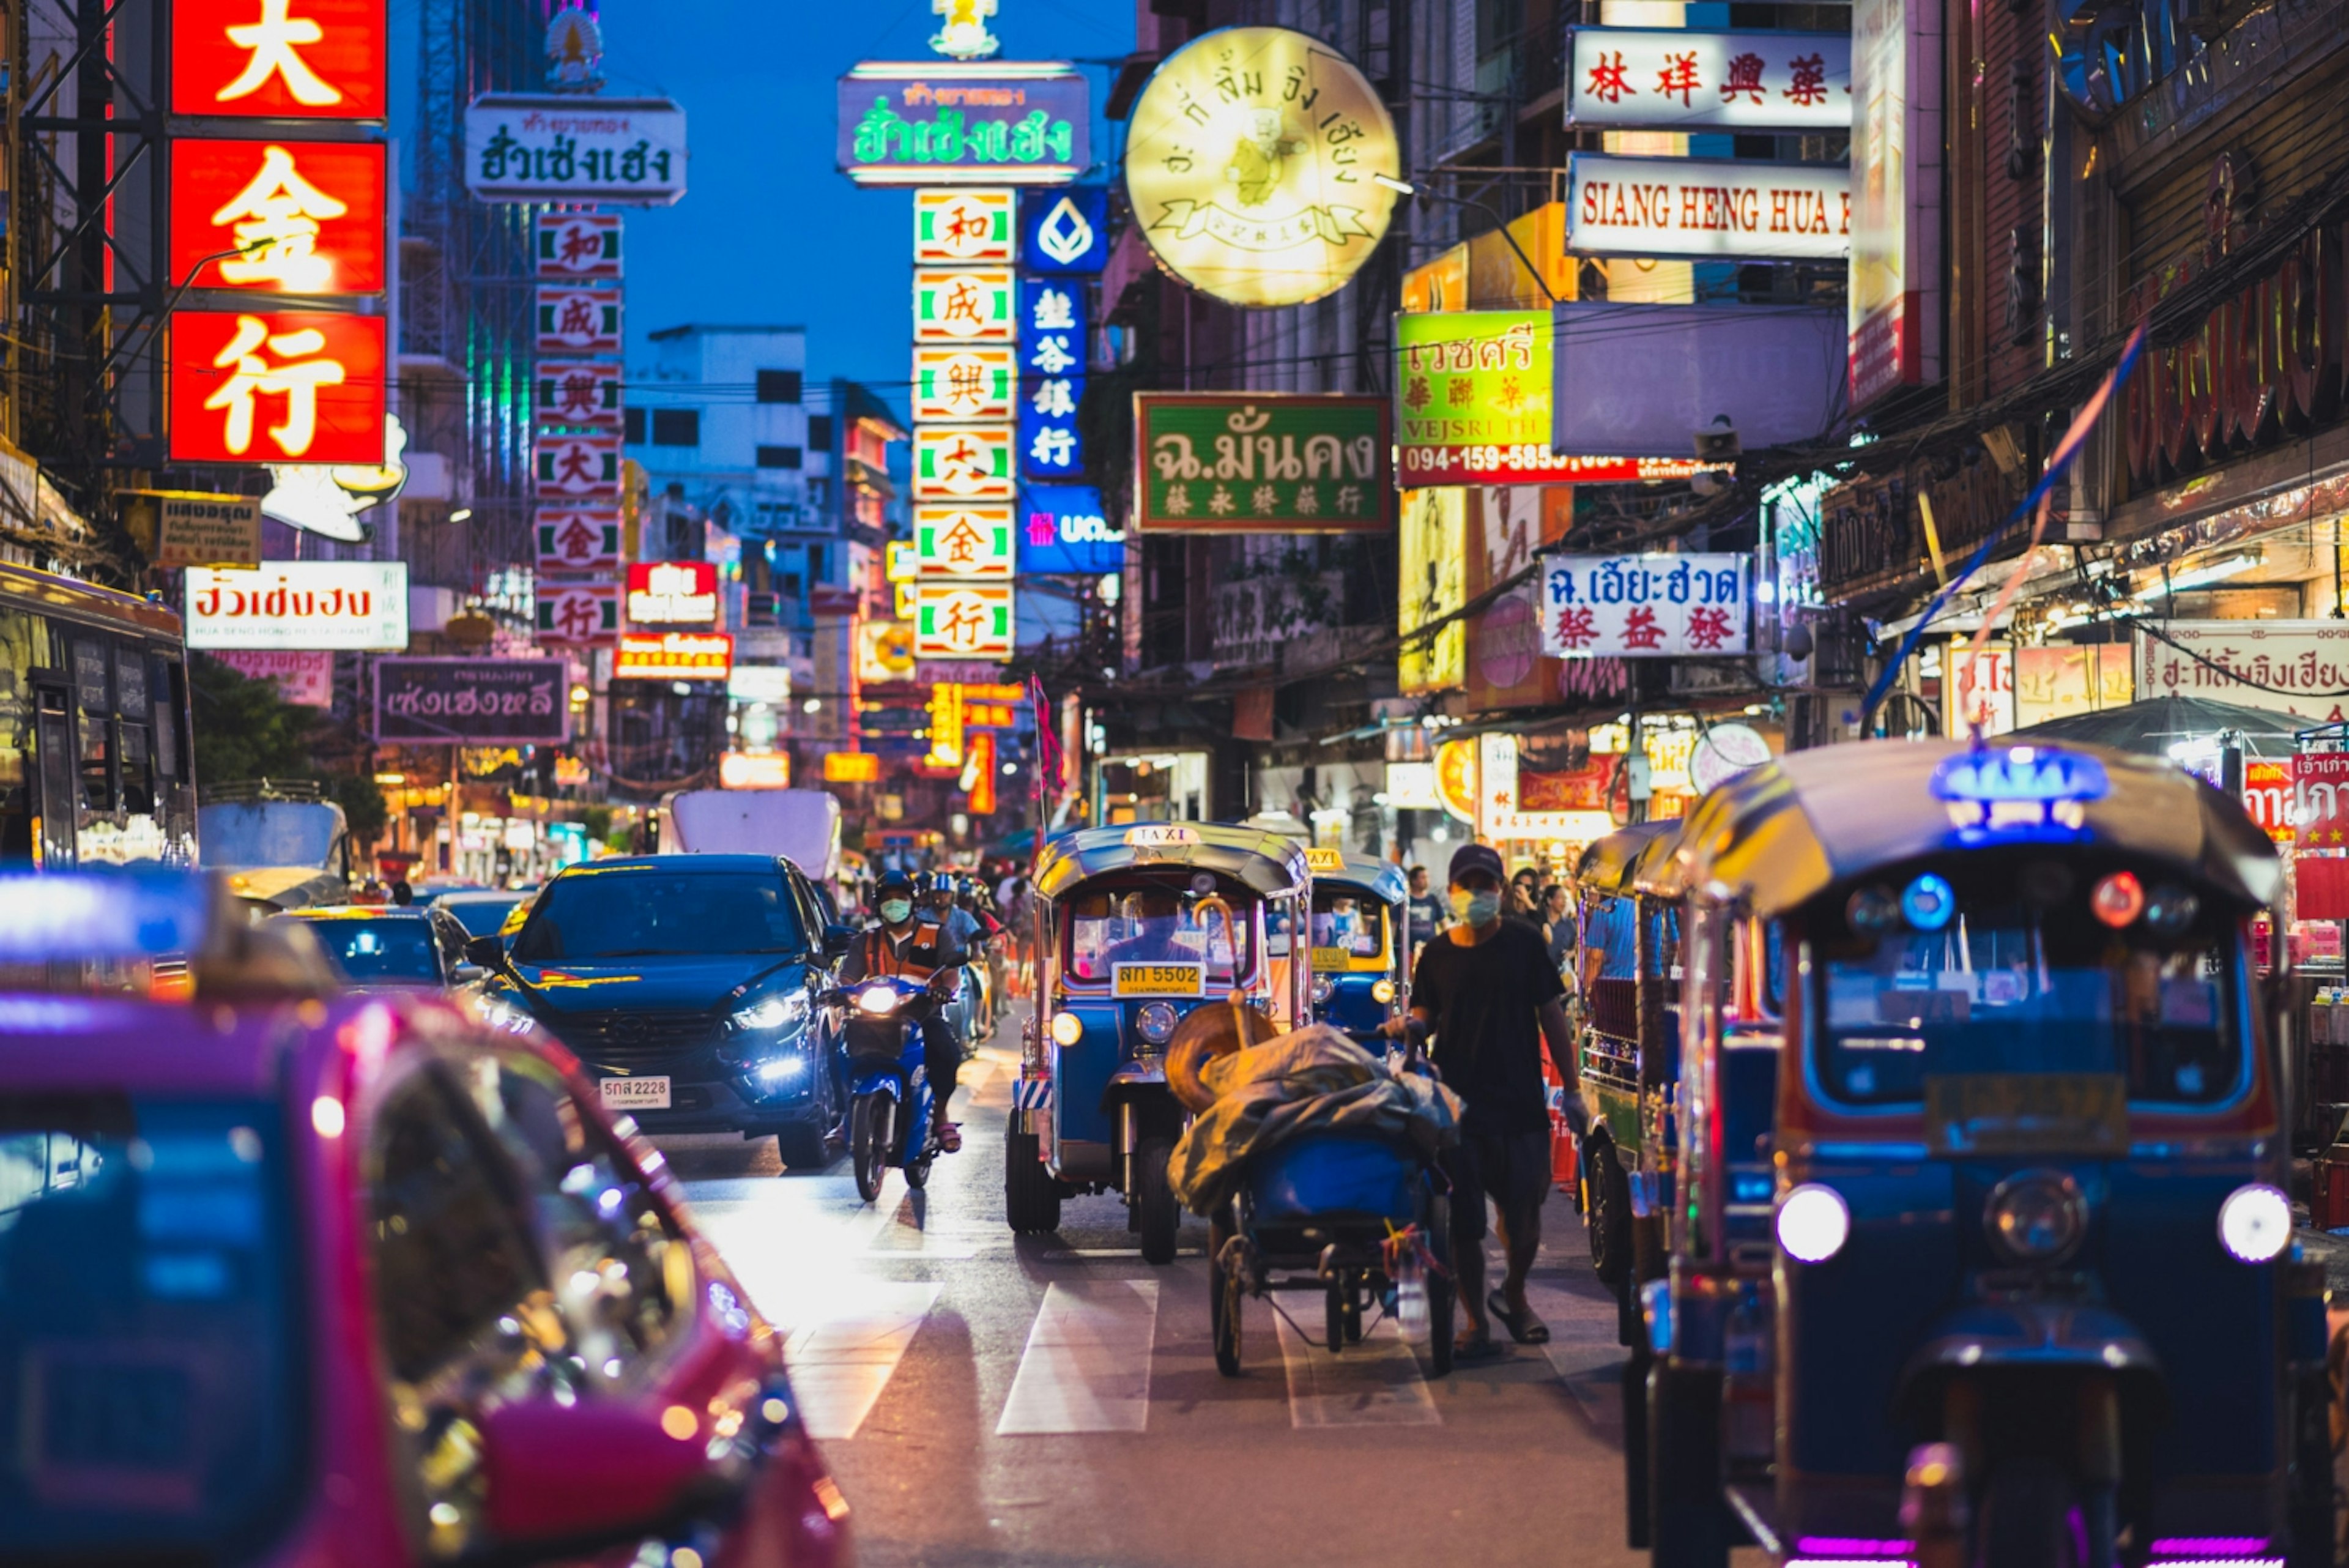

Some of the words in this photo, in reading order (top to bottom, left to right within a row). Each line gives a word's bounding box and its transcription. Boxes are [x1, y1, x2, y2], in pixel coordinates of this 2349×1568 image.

[1584, 50, 1852, 108] 林祥興藥
[1583, 182, 1671, 228] SIANG
[1680, 186, 1759, 232] HENG
[1769, 190, 1830, 234] HUA
[204, 0, 348, 456] 大金行
[1406, 420, 1493, 441] VEJSRI
[1154, 406, 1375, 480] ฉ.มั่นคง
[195, 626, 218, 636] HUA
[1141, 829, 1184, 840] TAXI
[1153, 966, 1198, 983] 5502
[634, 1081, 666, 1094] 2228
